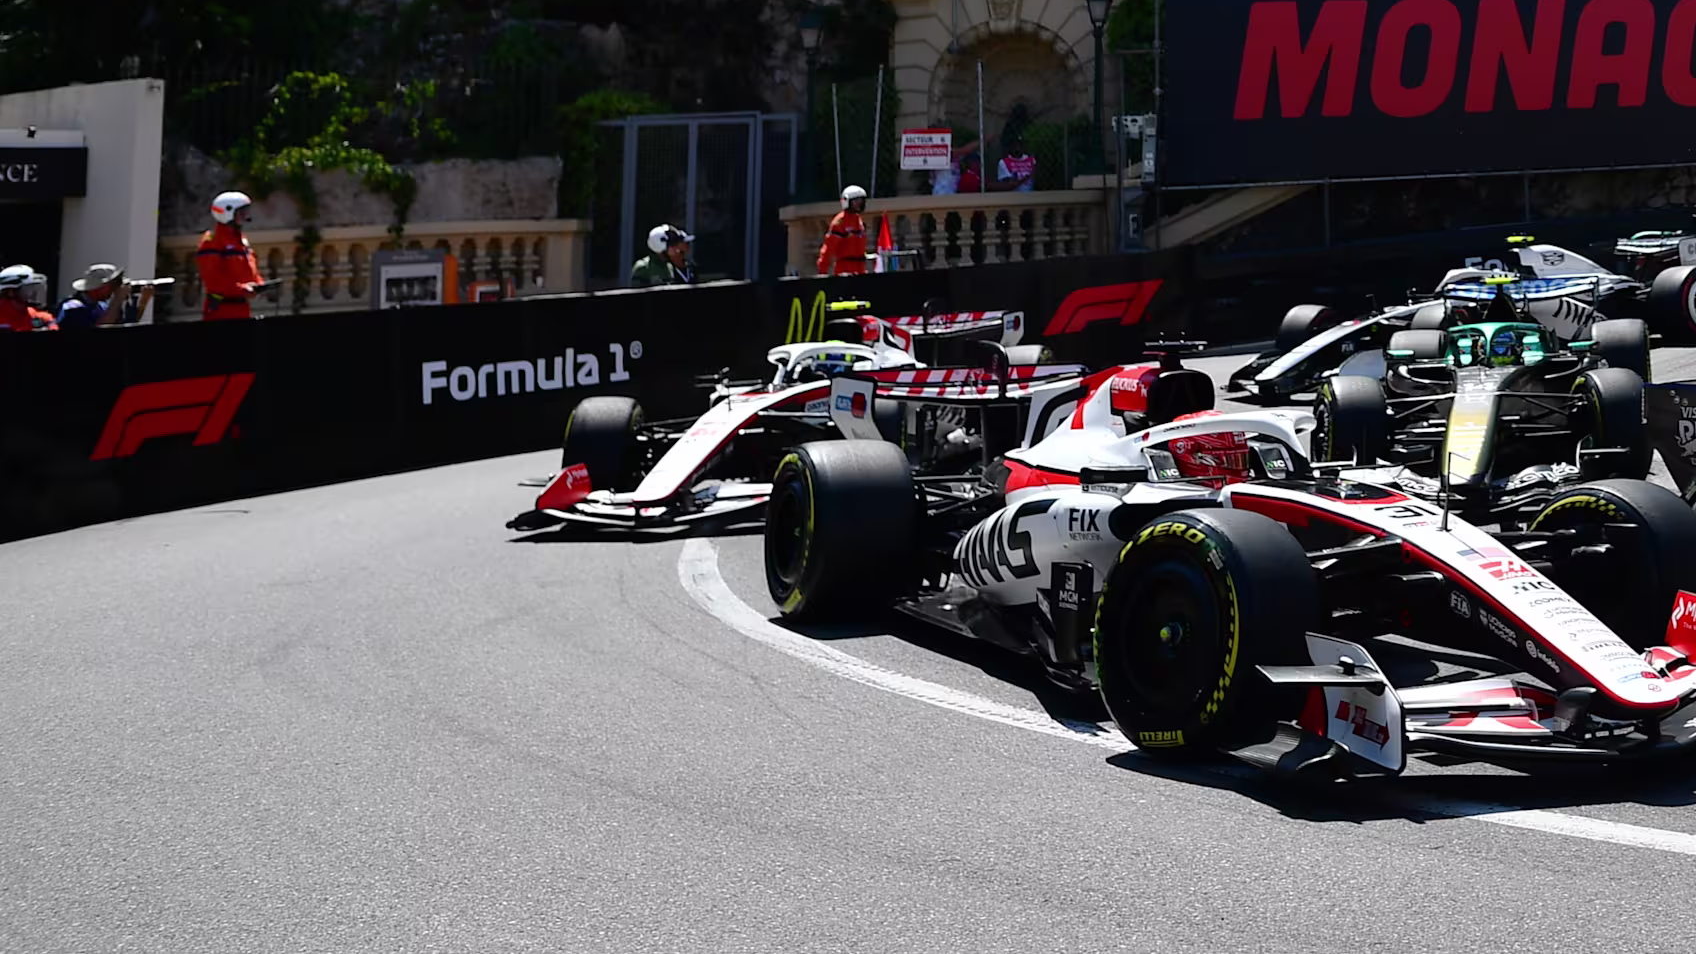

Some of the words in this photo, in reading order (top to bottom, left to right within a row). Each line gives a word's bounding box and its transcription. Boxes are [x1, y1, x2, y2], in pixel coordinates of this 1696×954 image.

[422, 347, 600, 405] Formula
[1068, 508, 1101, 532] FIX
[1137, 521, 1206, 545] ZERO
